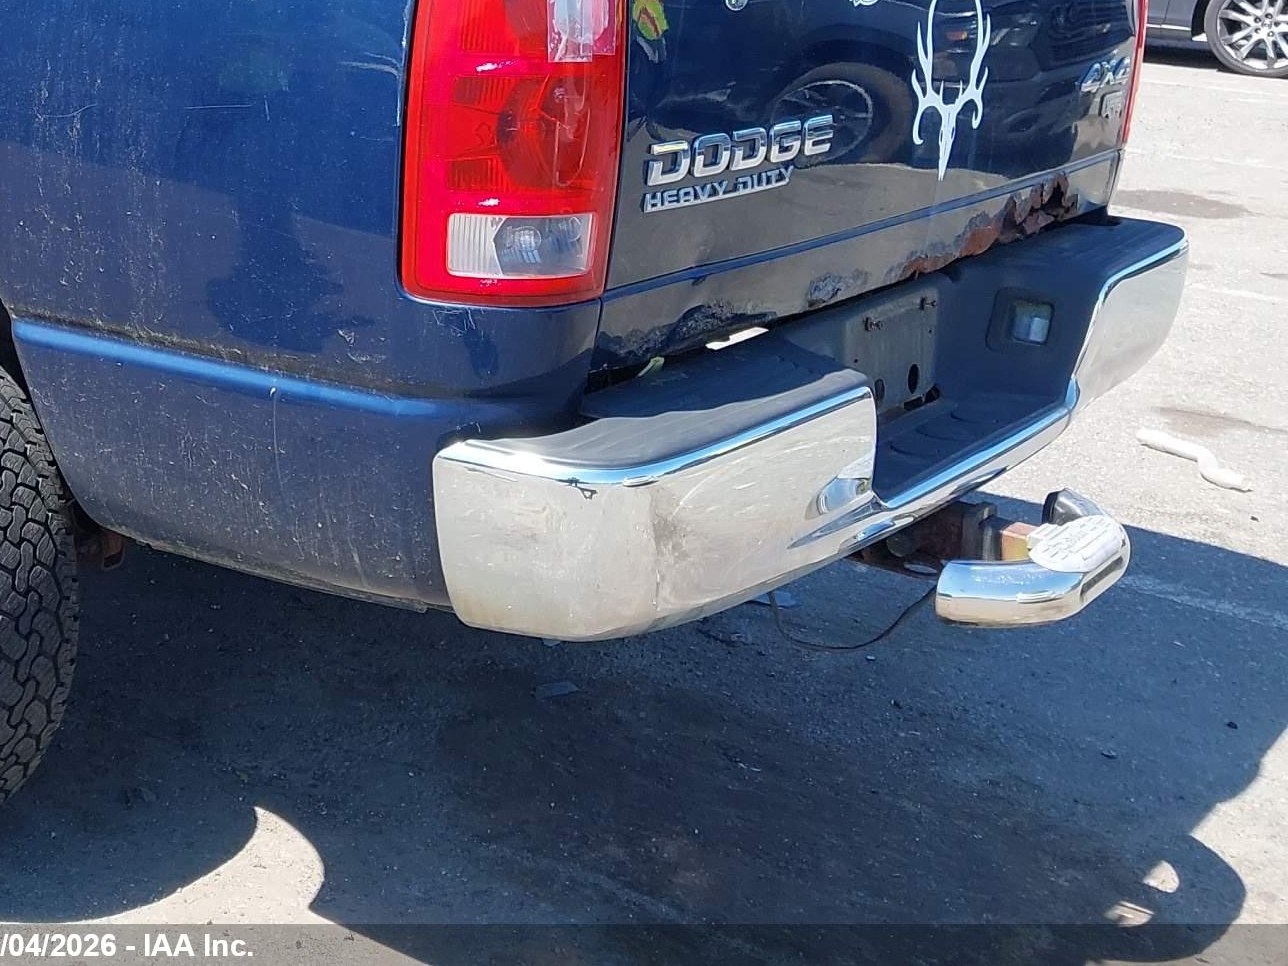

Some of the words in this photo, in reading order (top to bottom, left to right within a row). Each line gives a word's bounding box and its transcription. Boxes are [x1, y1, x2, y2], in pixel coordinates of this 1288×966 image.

[645, 114, 834, 187] DODGE
[644, 179, 729, 212] HEAVY
[736, 165, 794, 192] DUTY
